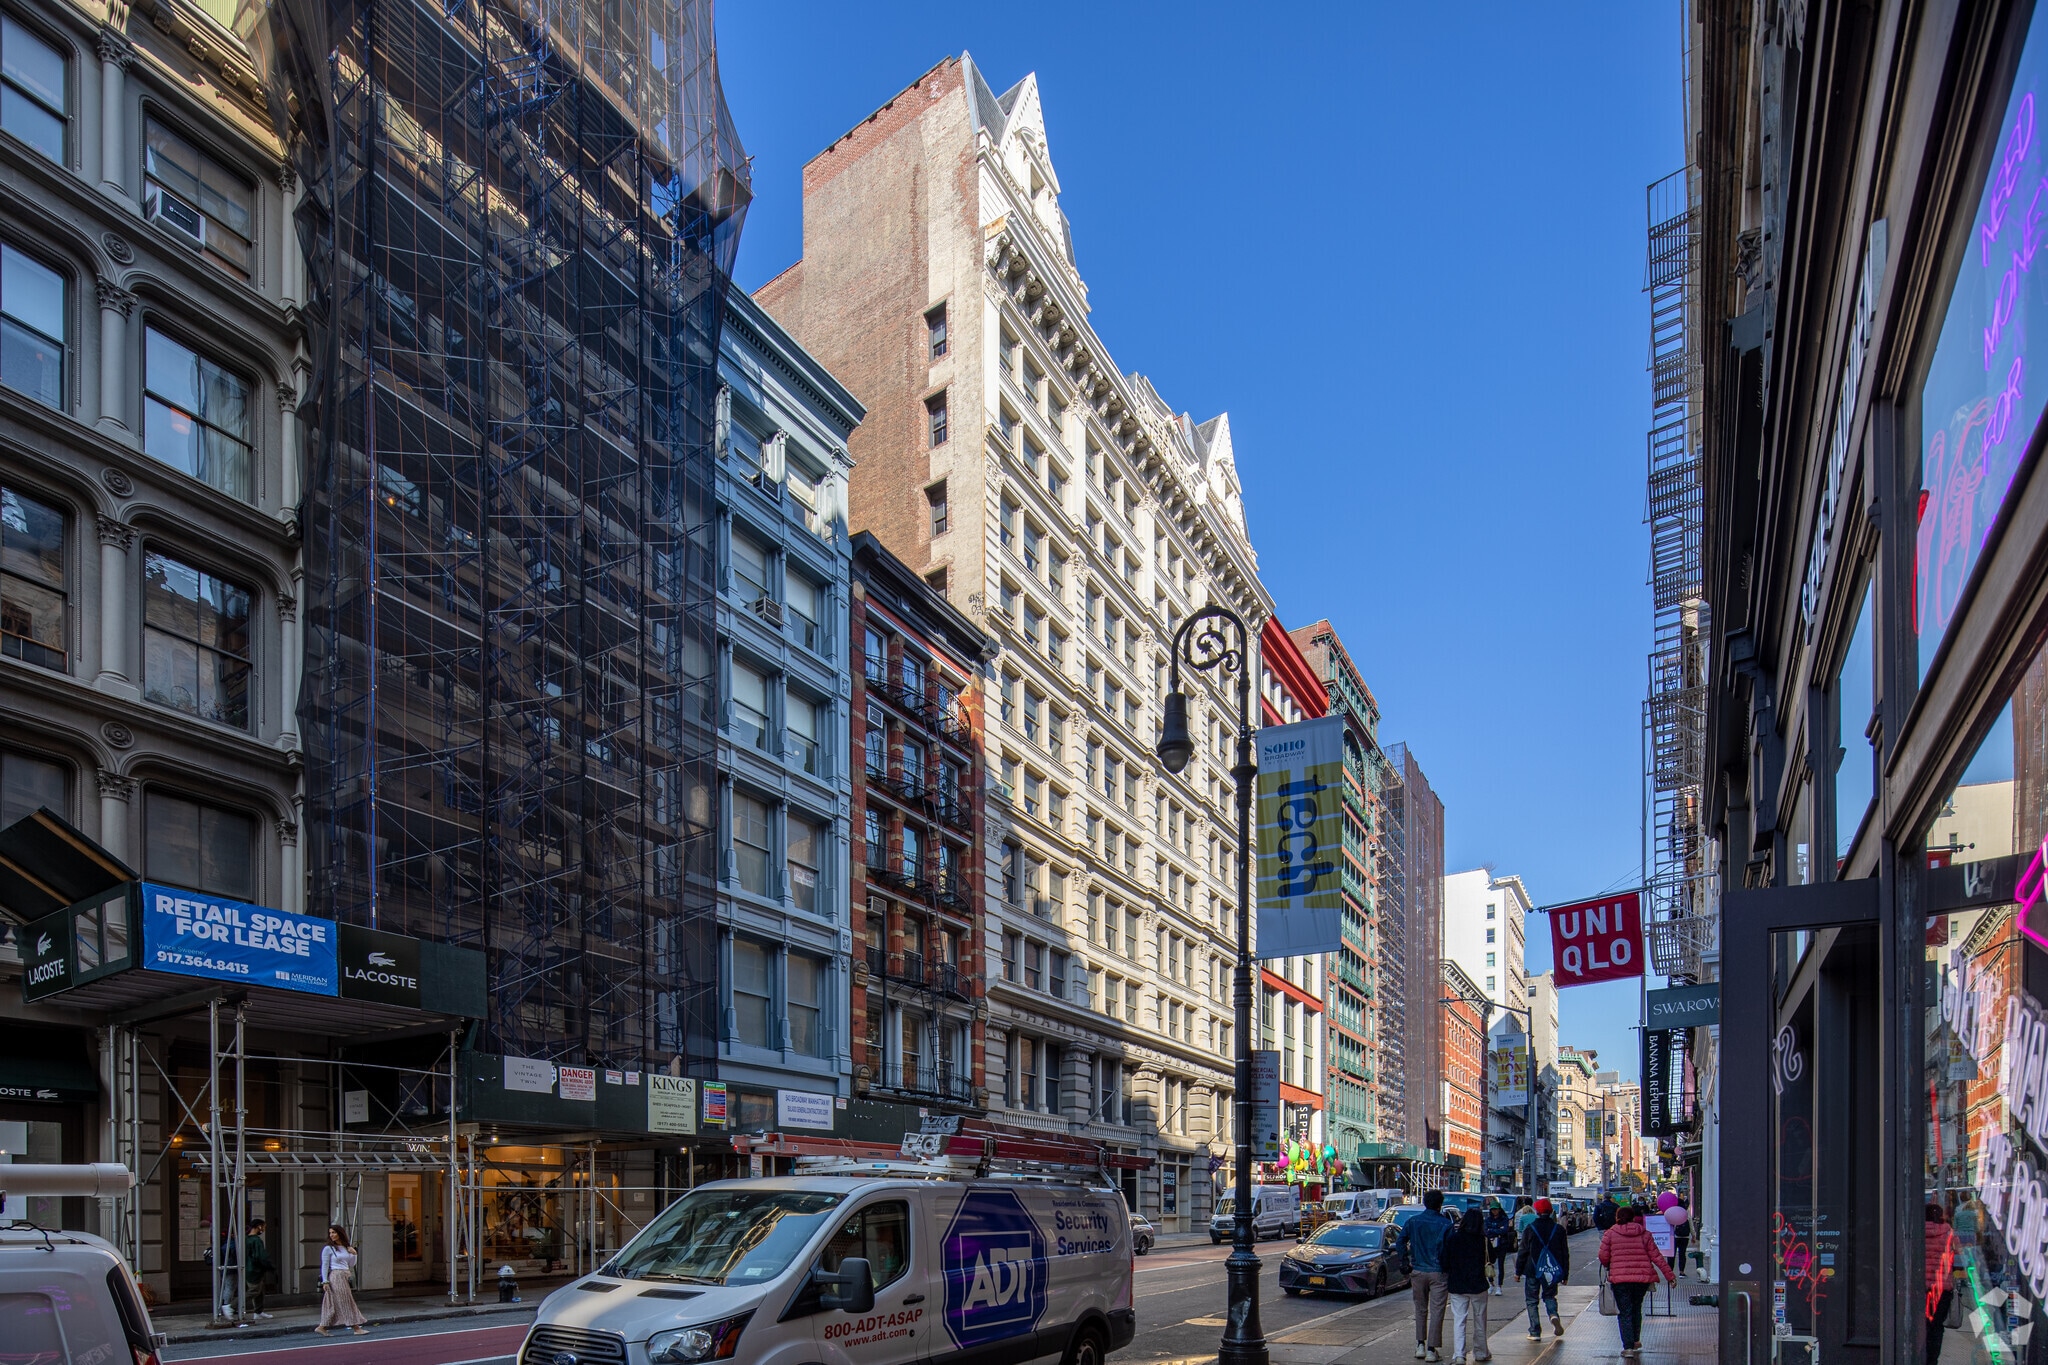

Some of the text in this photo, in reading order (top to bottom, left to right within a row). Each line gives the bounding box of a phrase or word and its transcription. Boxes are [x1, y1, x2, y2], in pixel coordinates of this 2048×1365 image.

[1982, 92, 2034, 268] NEED
[1982, 357, 2023, 477] FOR
[1264, 739, 1306, 756] SOHO
[1264, 750, 1305, 761] BROADWAY
[1277, 773, 1335, 899] tech
[155, 894, 326, 943] RETAIL SPACE
[1559, 903, 1623, 940] UNI
[176, 917, 310, 957] FOR LEASE
[157, 943, 208, 957] Vince Sweeney
[1562, 938, 1632, 977] QLO
[28, 957, 65, 986] LACOSTE
[157, 950, 249, 975] 917.364.8413
[291, 973, 328, 984] MERIDIAN
[344, 966, 418, 990] LACOSTE
[561, 1068, 594, 1080] DANGER
[652, 1076, 693, 1093] KINGS
[1648, 1035, 1660, 1129] BANANA REPUBLIC
[1299, 1106, 1309, 1136] SEPH
[1163, 1171, 1175, 1179] OFFICE
[1082, 1200, 1106, 1208] Commercial
[1055, 1210, 1108, 1234] Security
[1057, 1235, 1112, 1256] Services
[963, 1246, 1033, 1311] ADT
[1784, 1268, 1807, 1277] VISA
[824, 1308, 923, 1340] 800-ADT-ASAP
[844, 1327, 908, 1349] www.adt.com
